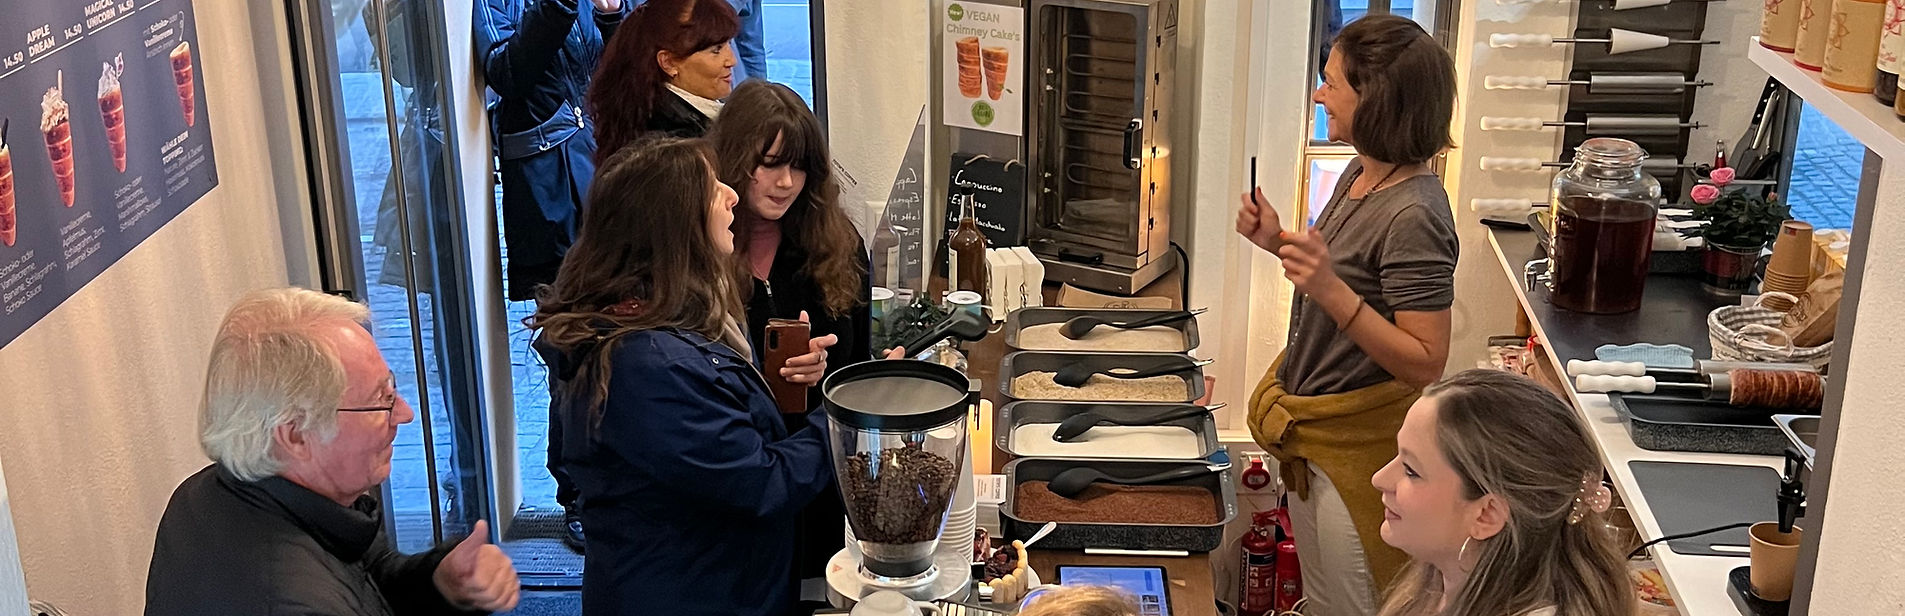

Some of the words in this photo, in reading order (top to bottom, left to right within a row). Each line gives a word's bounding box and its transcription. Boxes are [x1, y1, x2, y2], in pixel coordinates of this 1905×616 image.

[84, 0, 114, 16] MAGICAL
[86, 8, 116, 29] UNICORN
[118, 0, 134, 13] 14.50
[966, 10, 1000, 24] VEGAN
[27, 24, 51, 44] APPLE
[28, 36, 55, 57] DREAM
[64, 23, 83, 40] 14.50
[946, 23, 988, 39] Chimney
[990, 28, 1020, 42] Cake's
[3, 51, 24, 69] 14.50
